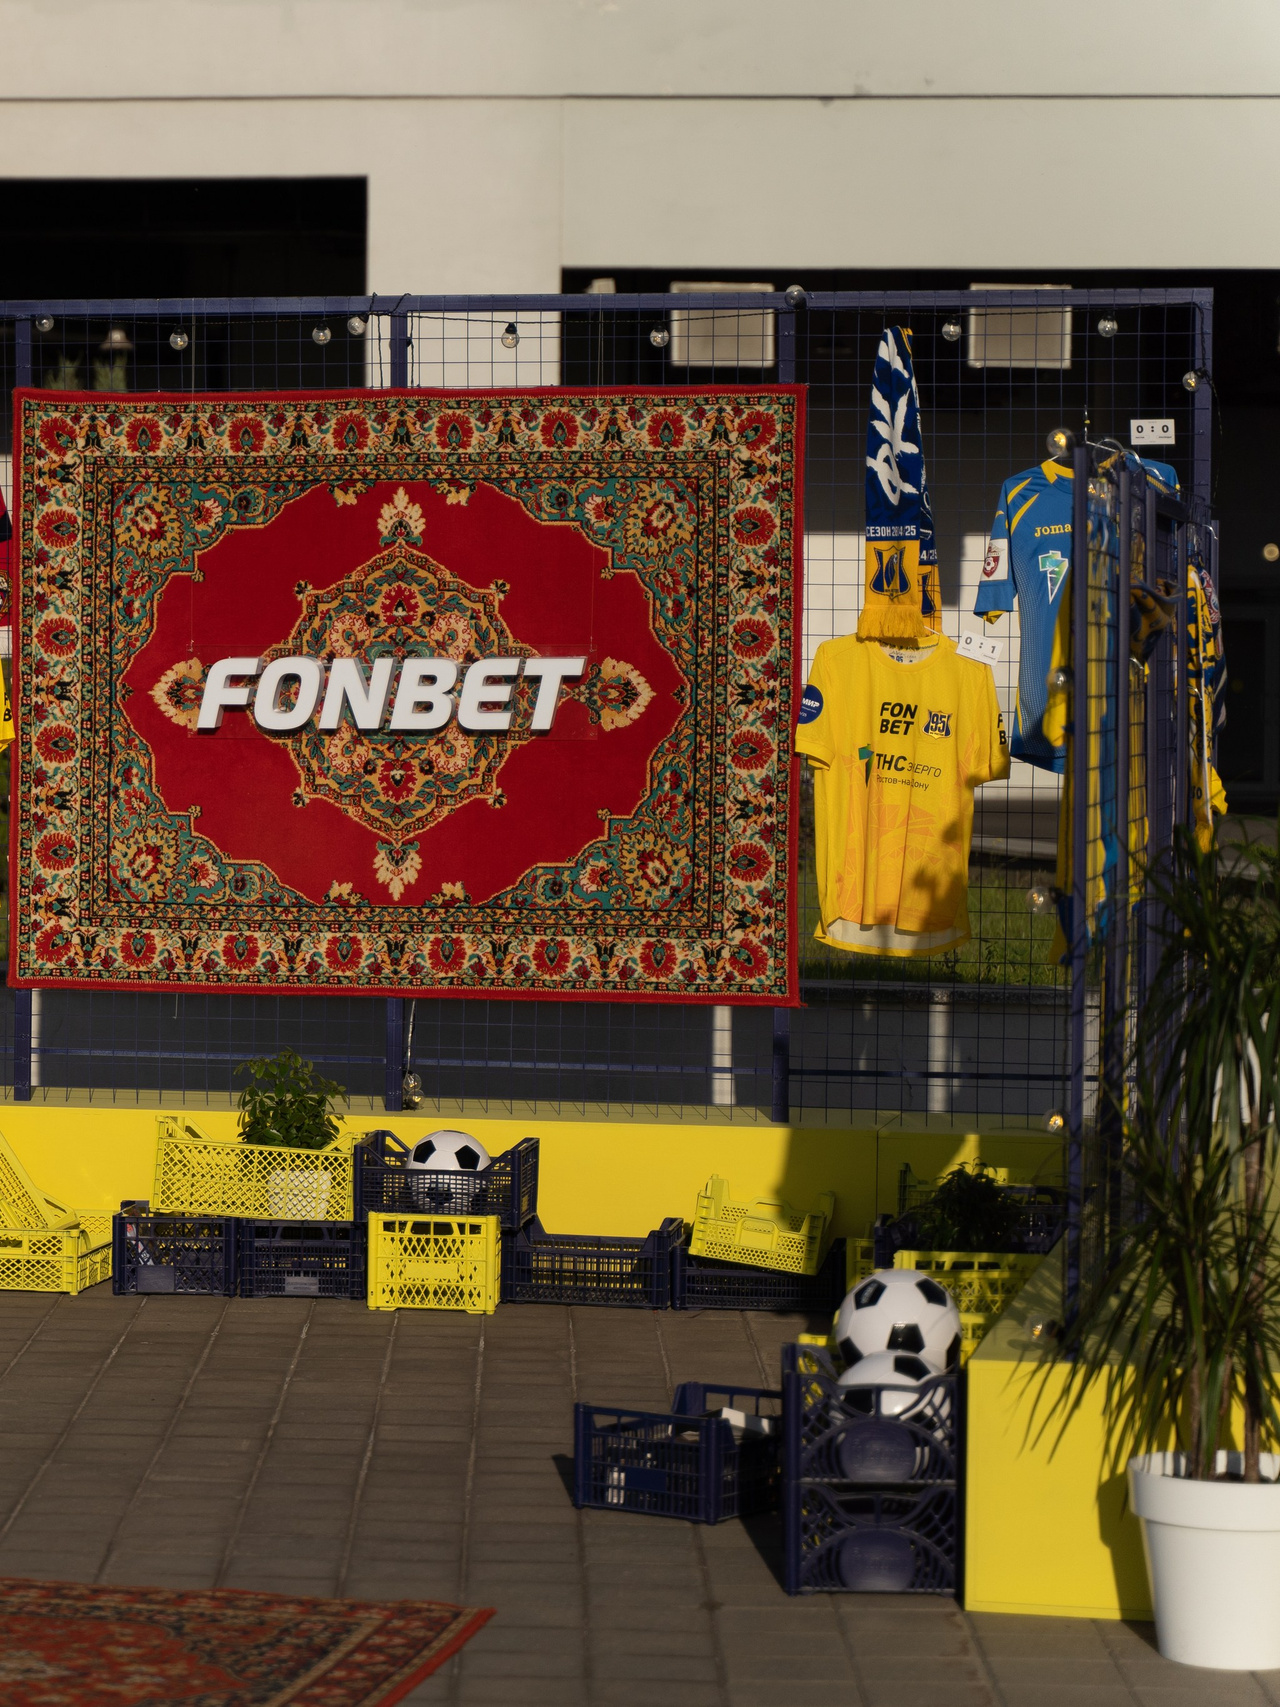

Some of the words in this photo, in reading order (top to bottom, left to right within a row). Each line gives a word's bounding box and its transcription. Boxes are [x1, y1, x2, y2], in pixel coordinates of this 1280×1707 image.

[197, 655, 588, 733] FONBET
[880, 702, 918, 719] FON
[880, 719, 914, 735] BET
[930, 713, 947, 733] 95
[876, 753, 907, 771] ТНС
[907, 762, 942, 778] ЭЕРГО
